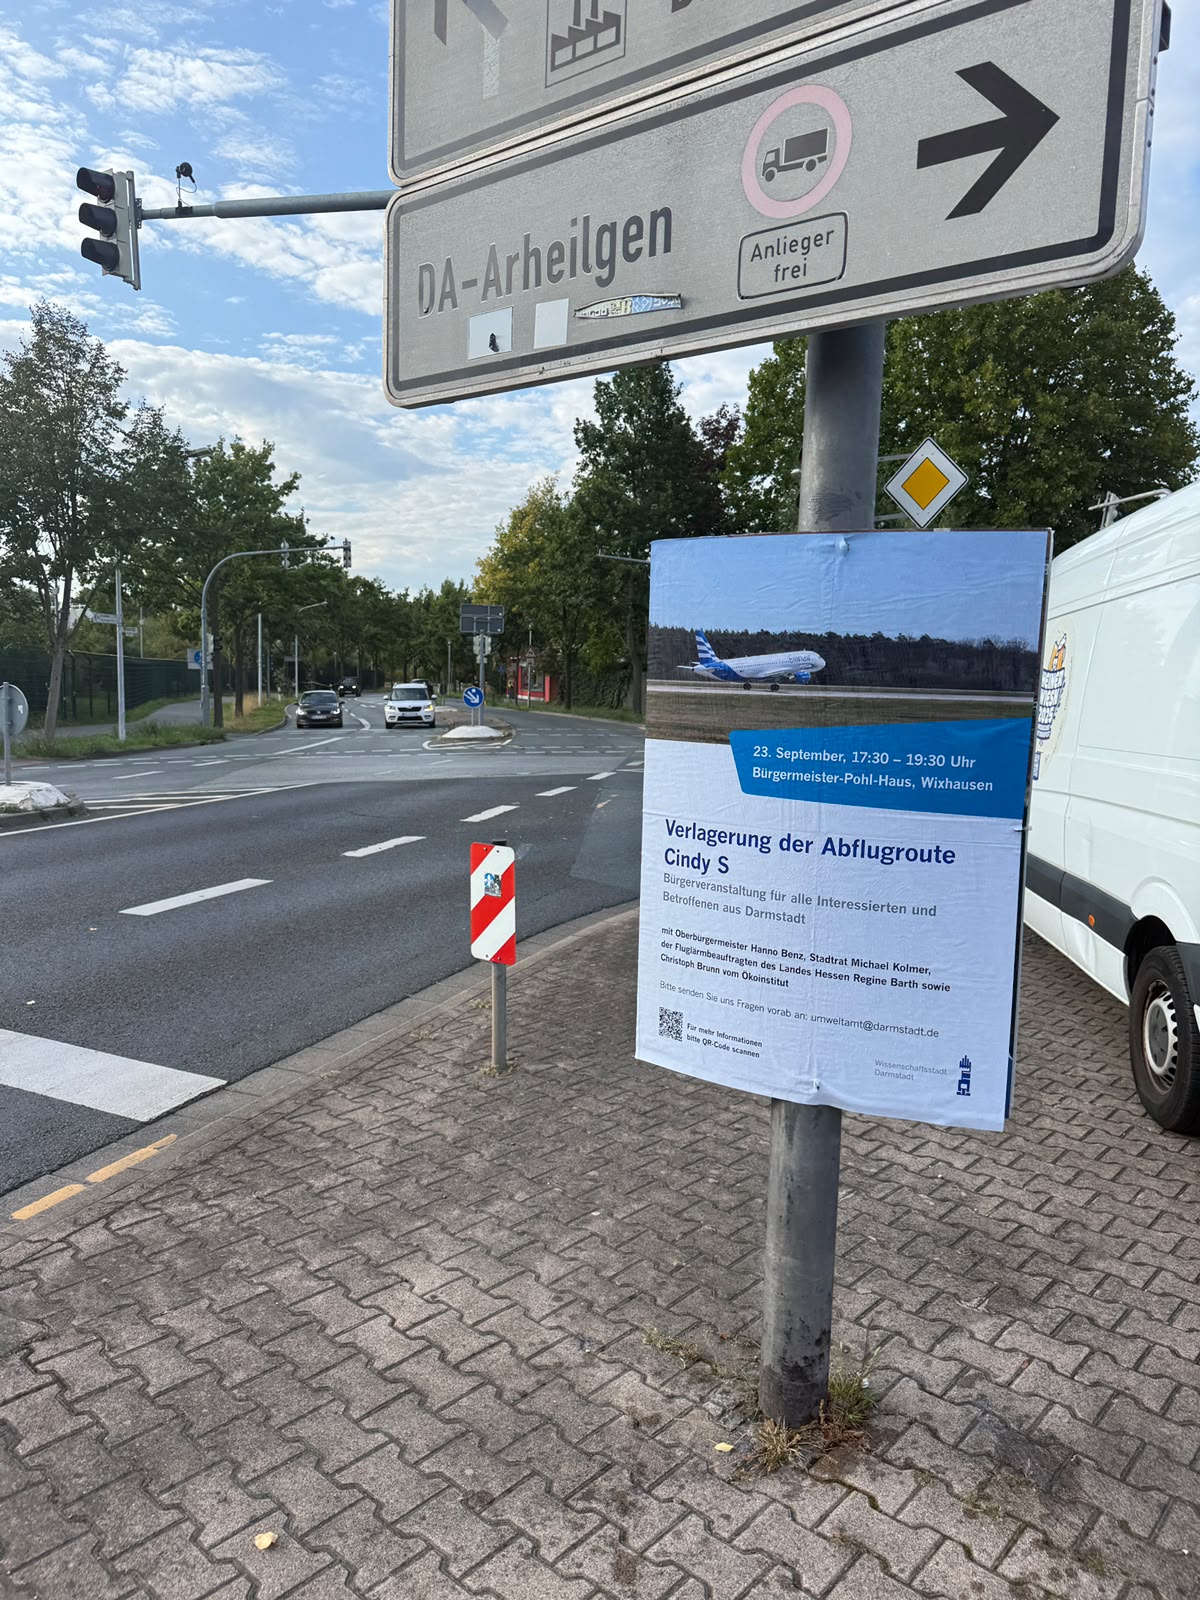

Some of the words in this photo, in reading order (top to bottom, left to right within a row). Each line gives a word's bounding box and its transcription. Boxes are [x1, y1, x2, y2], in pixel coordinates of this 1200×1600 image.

[750, 229, 834, 262] Anlieger
[418, 206, 672, 318] DA-Arheilgen
[774, 261, 807, 283] frei
[753, 745, 771, 758] 23.
[776, 747, 846, 764] September,
[852, 751, 889, 765] 17:30
[906, 753, 945, 767] 19:30
[950, 755, 976, 768] Uhr
[752, 766, 915, 789] Bürgermeister-Pohl-Haus,
[921, 776, 993, 791] Wixhausen
[665, 818, 772, 854] Verlagerung
[779, 833, 813, 853] der
[821, 836, 956, 866] Abflugroute
[664, 847, 710, 875] Cindy
[718, 855, 729, 874] S
[663, 872, 767, 901] Bürgerveranstaltung
[770, 889, 786, 902] für
[790, 892, 812, 905] alle
[817, 895, 907, 915] Interessierten
[912, 905, 937, 916] und
[663, 891, 719, 911] Betroffenen
[723, 903, 741, 914] aus
[745, 905, 806, 924] Darmstadt
[661, 927, 673, 936] mit
[751, 944, 778, 956] Hanno
[781, 949, 806, 961] Benz,
[809, 953, 848, 966] Stadtrat
[851, 958, 889, 970] Michael
[893, 962, 931, 975] Kolmer,
[660, 953, 694, 969] Christoph
[697, 962, 720, 974] Brunn
[722, 969, 739, 978] vom
[661, 940, 673, 949] der
[760, 960, 776, 971] des
[779, 963, 811, 976] Landes
[815, 969, 850, 981] Hessen
[853, 973, 887, 986] Regine
[890, 977, 918, 989] Barth
[921, 982, 951, 992] sowie
[660, 980, 676, 991] Bitte
[678, 986, 704, 999] senden
[706, 992, 718, 1002] Sie
[720, 997, 734, 1006] uns
[737, 999, 764, 1012] Fragen
[767, 1006, 791, 1018] vorab
[794, 1012, 808, 1020] an:
[811, 1014, 939, 1038] umweltamt@darmstadt.de
[686, 1033, 701, 1043] bitte
[702, 1037, 730, 1051] QR-Code
[732, 1047, 760, 1058] scannen
[699, 1026, 715, 1036] mehr
[716, 1030, 763, 1047] Informationen
[874, 1059, 947, 1075] Wissenschaftsstadt
[874, 1069, 914, 1081] Darmstadt
